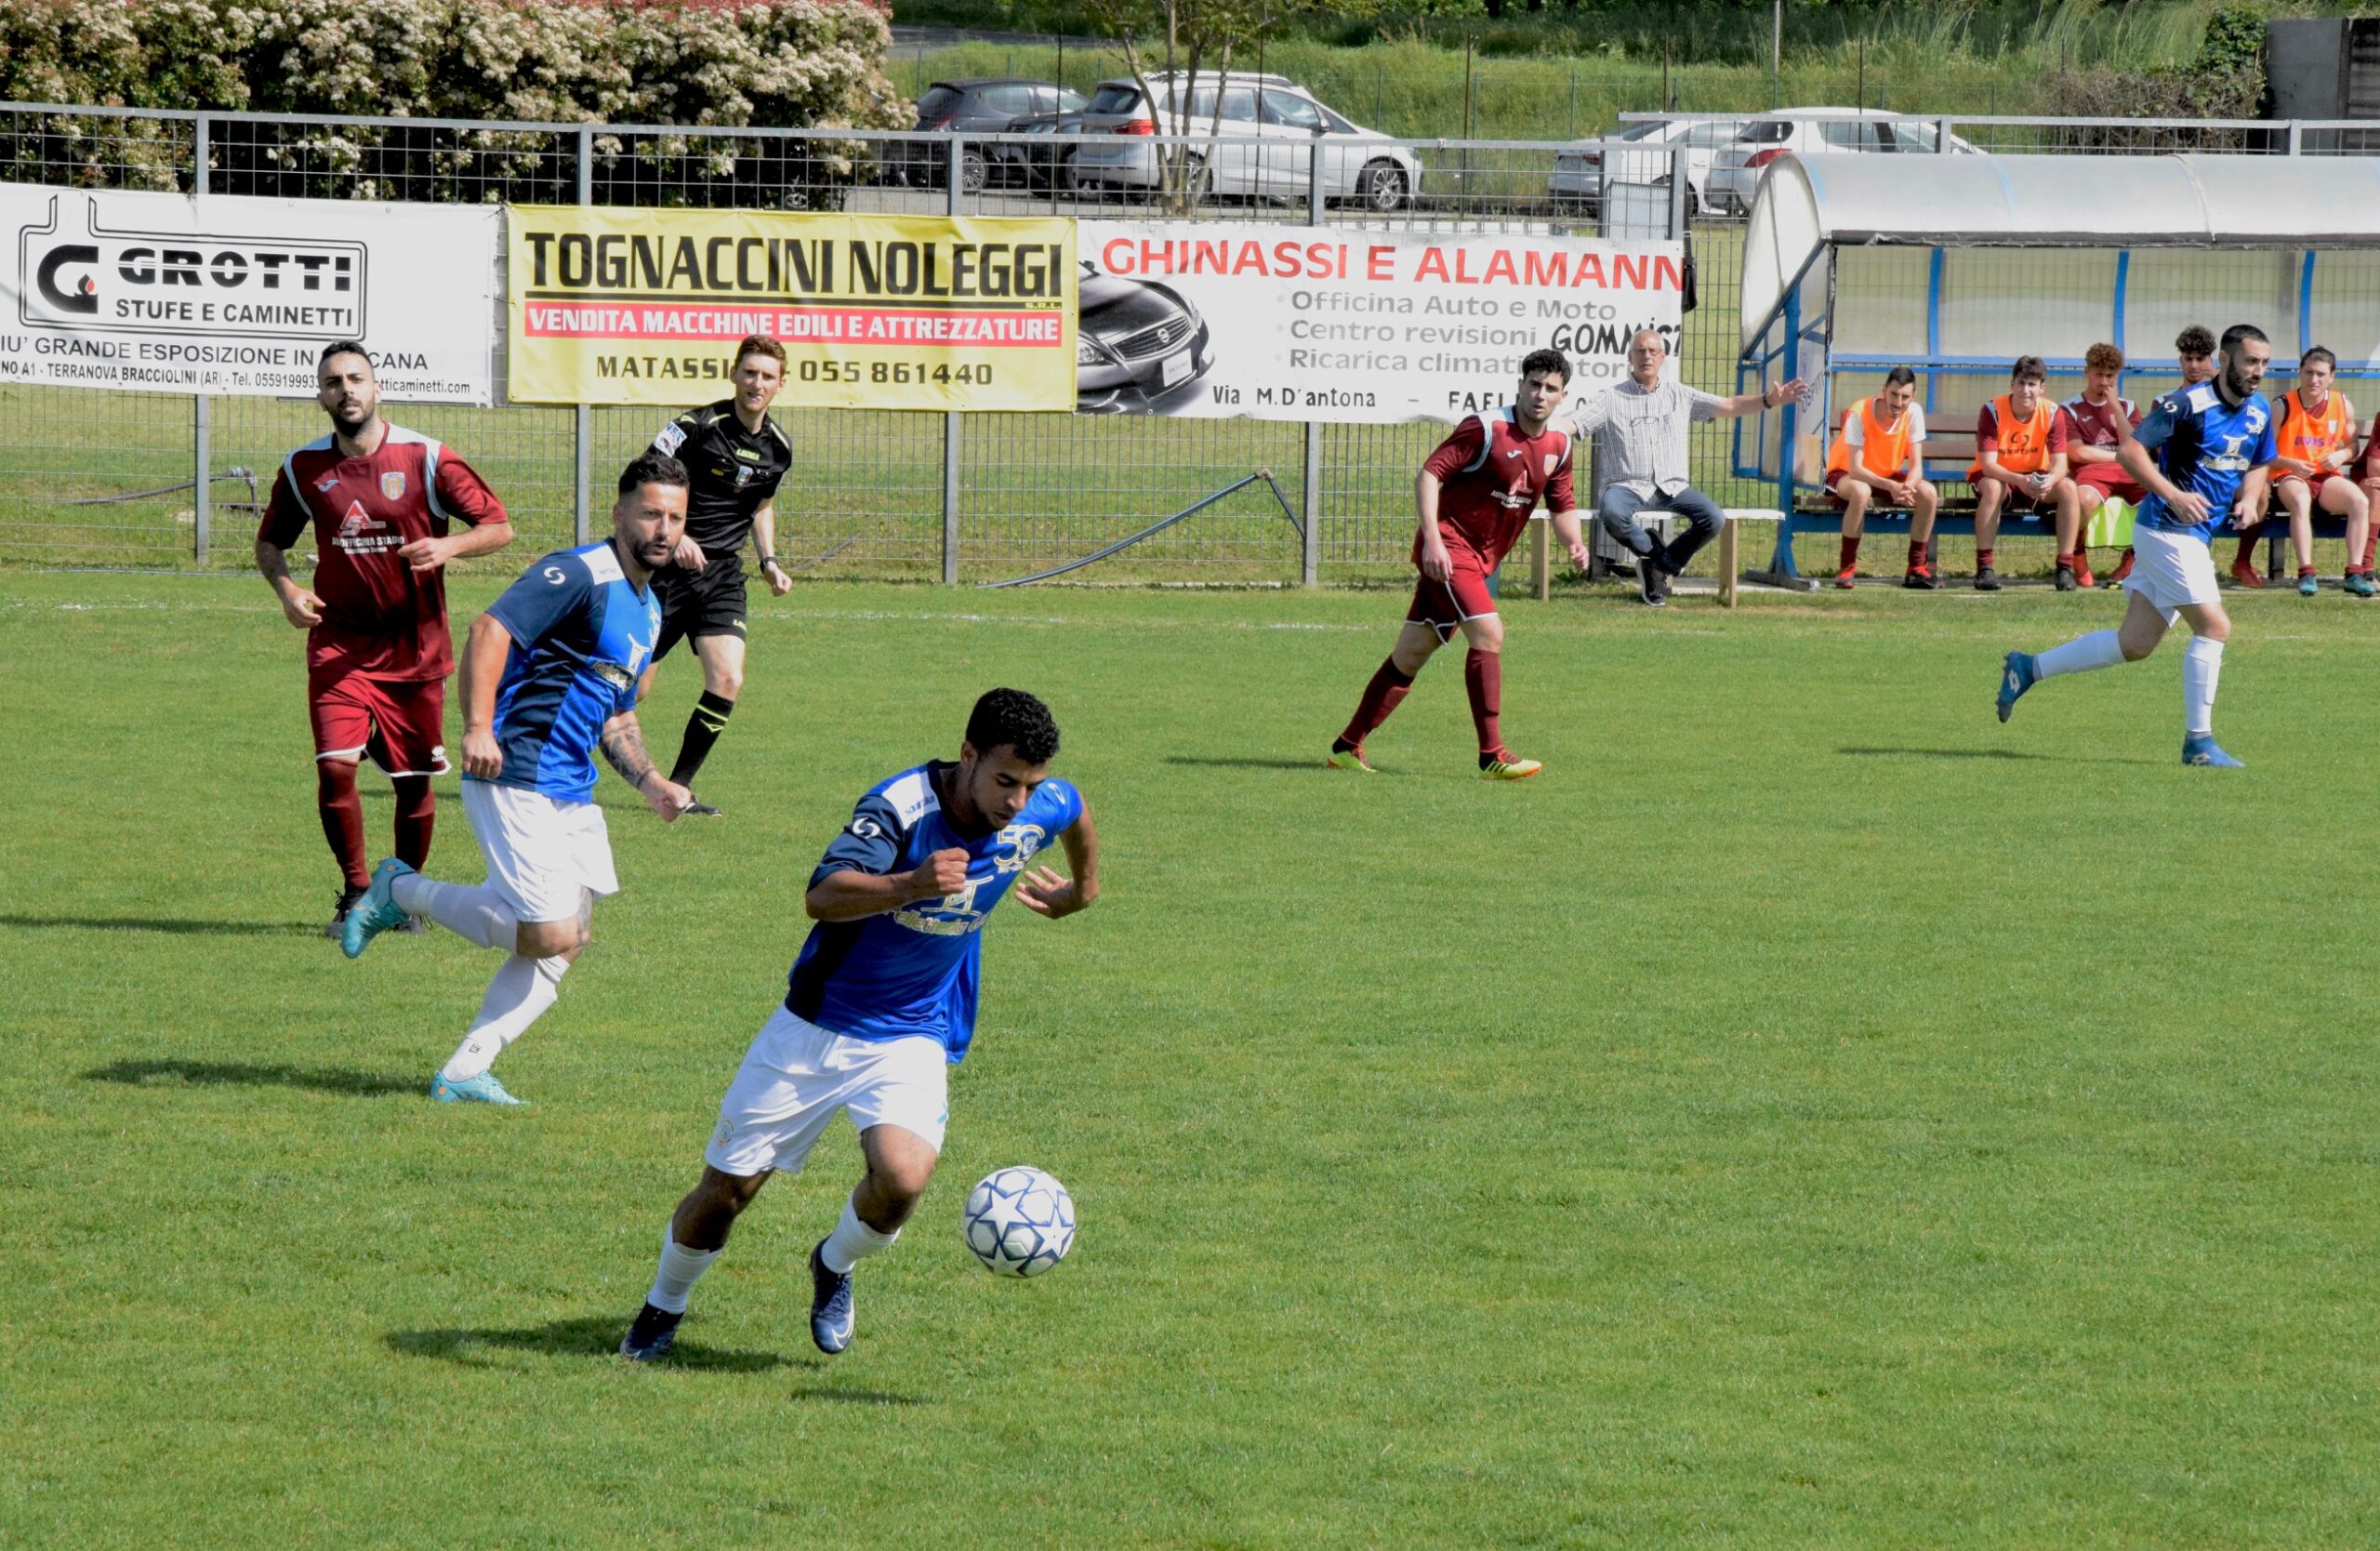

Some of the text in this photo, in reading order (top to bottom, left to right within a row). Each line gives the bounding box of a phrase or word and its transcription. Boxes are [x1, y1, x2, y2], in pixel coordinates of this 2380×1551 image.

[117, 247, 351, 291] GROTTI
[525, 232, 1062, 297] TOGNACCINI NOLEGGI
[1103, 237, 1346, 279] GHINASSI
[1368, 245, 1394, 281] E
[116, 298, 351, 327] STUFE E CAMINETTI
[1291, 291, 1616, 321] Officina Auto e Moto
[529, 307, 1059, 341] VENDITA MACCHINE EDILI E ATTREZZATURE
[1290, 319, 1536, 346] Centro revisioni
[1, 336, 428, 370] IU' GRANDE ESPOSIZIONE IN CANA
[1289, 349, 1408, 371] Ricarica
[1, 360, 19, 375] NO
[21, 362, 35, 376] A1
[47, 363, 118, 380] TERRANOVA
[122, 367, 196, 384] BRACCIOLINI
[200, 370, 222, 388] (AR)
[232, 372, 251, 387] Tel.
[597, 355, 730, 379] MATASSI
[800, 361, 861, 383] 055
[871, 362, 994, 386] 861440
[1212, 386, 1240, 405] Via
